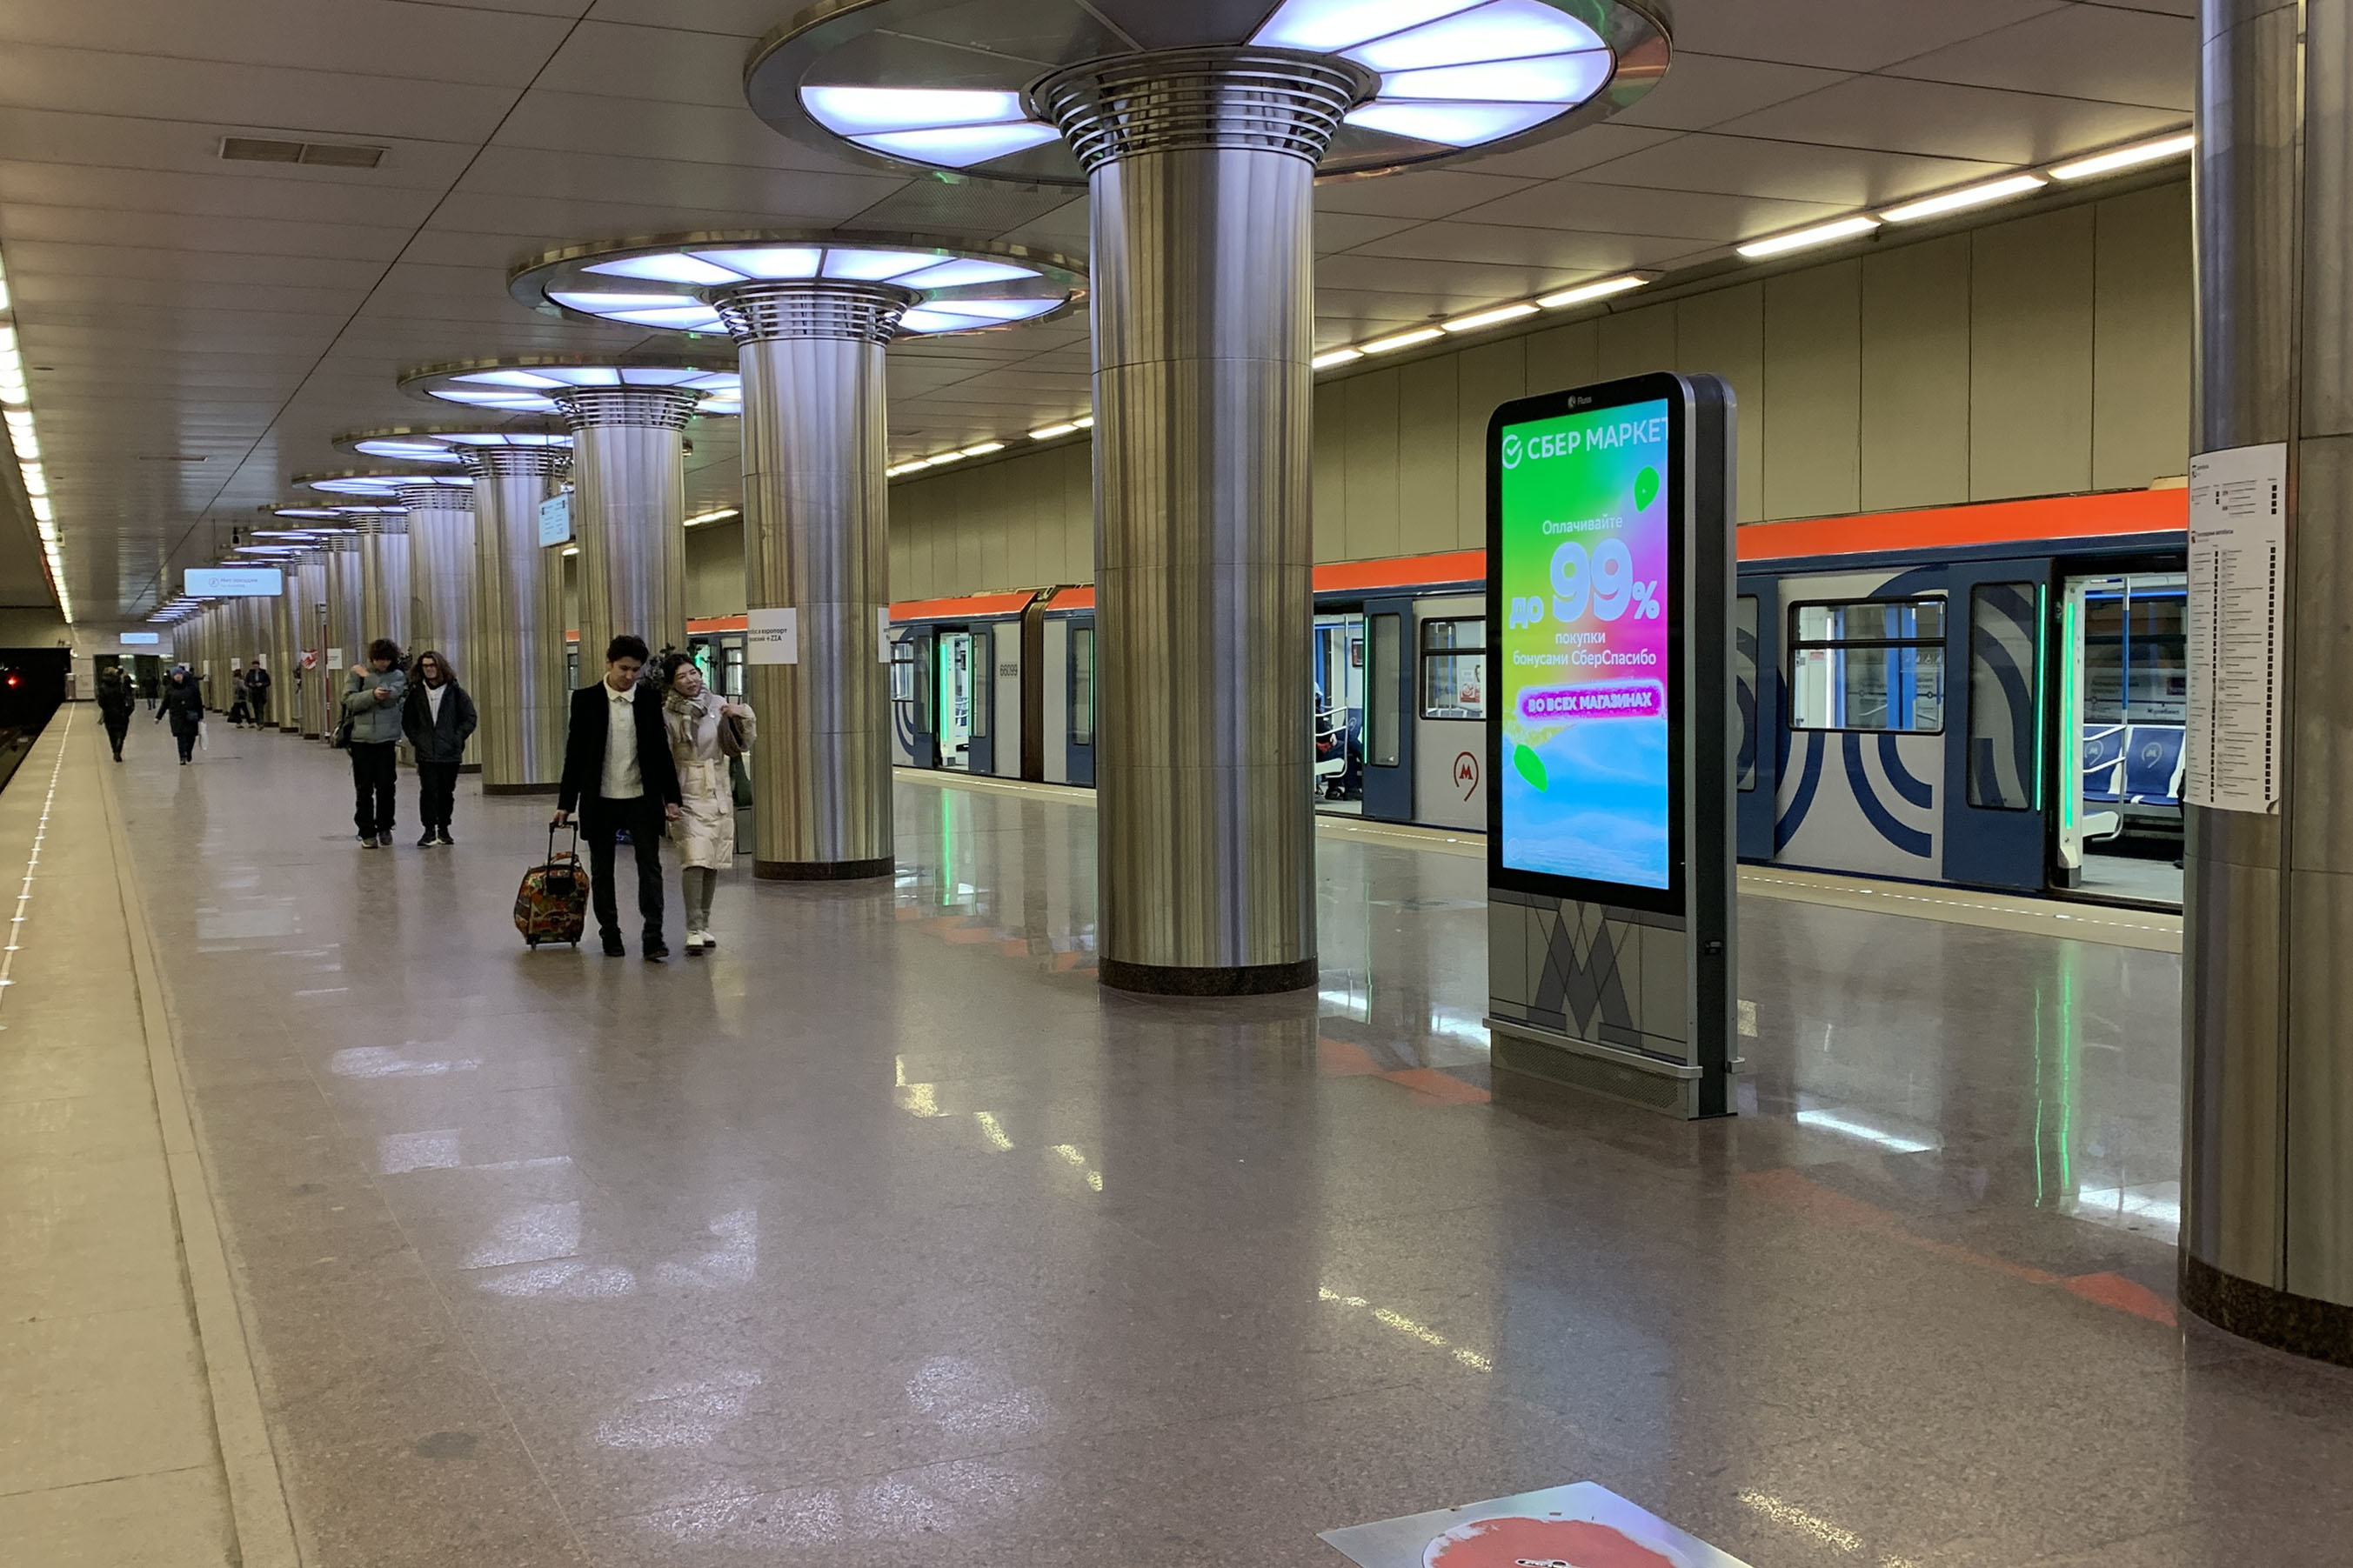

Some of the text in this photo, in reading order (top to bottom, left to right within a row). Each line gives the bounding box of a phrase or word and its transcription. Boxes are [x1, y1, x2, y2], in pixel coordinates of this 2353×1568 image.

[1527, 431, 1581, 460] СБЕР
[1542, 513, 1623, 535] Оплачивайте
[1555, 631, 1606, 647] покупки
[1513, 648, 1657, 668] бонусами СберСпасибо
[1527, 692, 1653, 712] ВО ВСЕХ МАГАЗИНАХ
